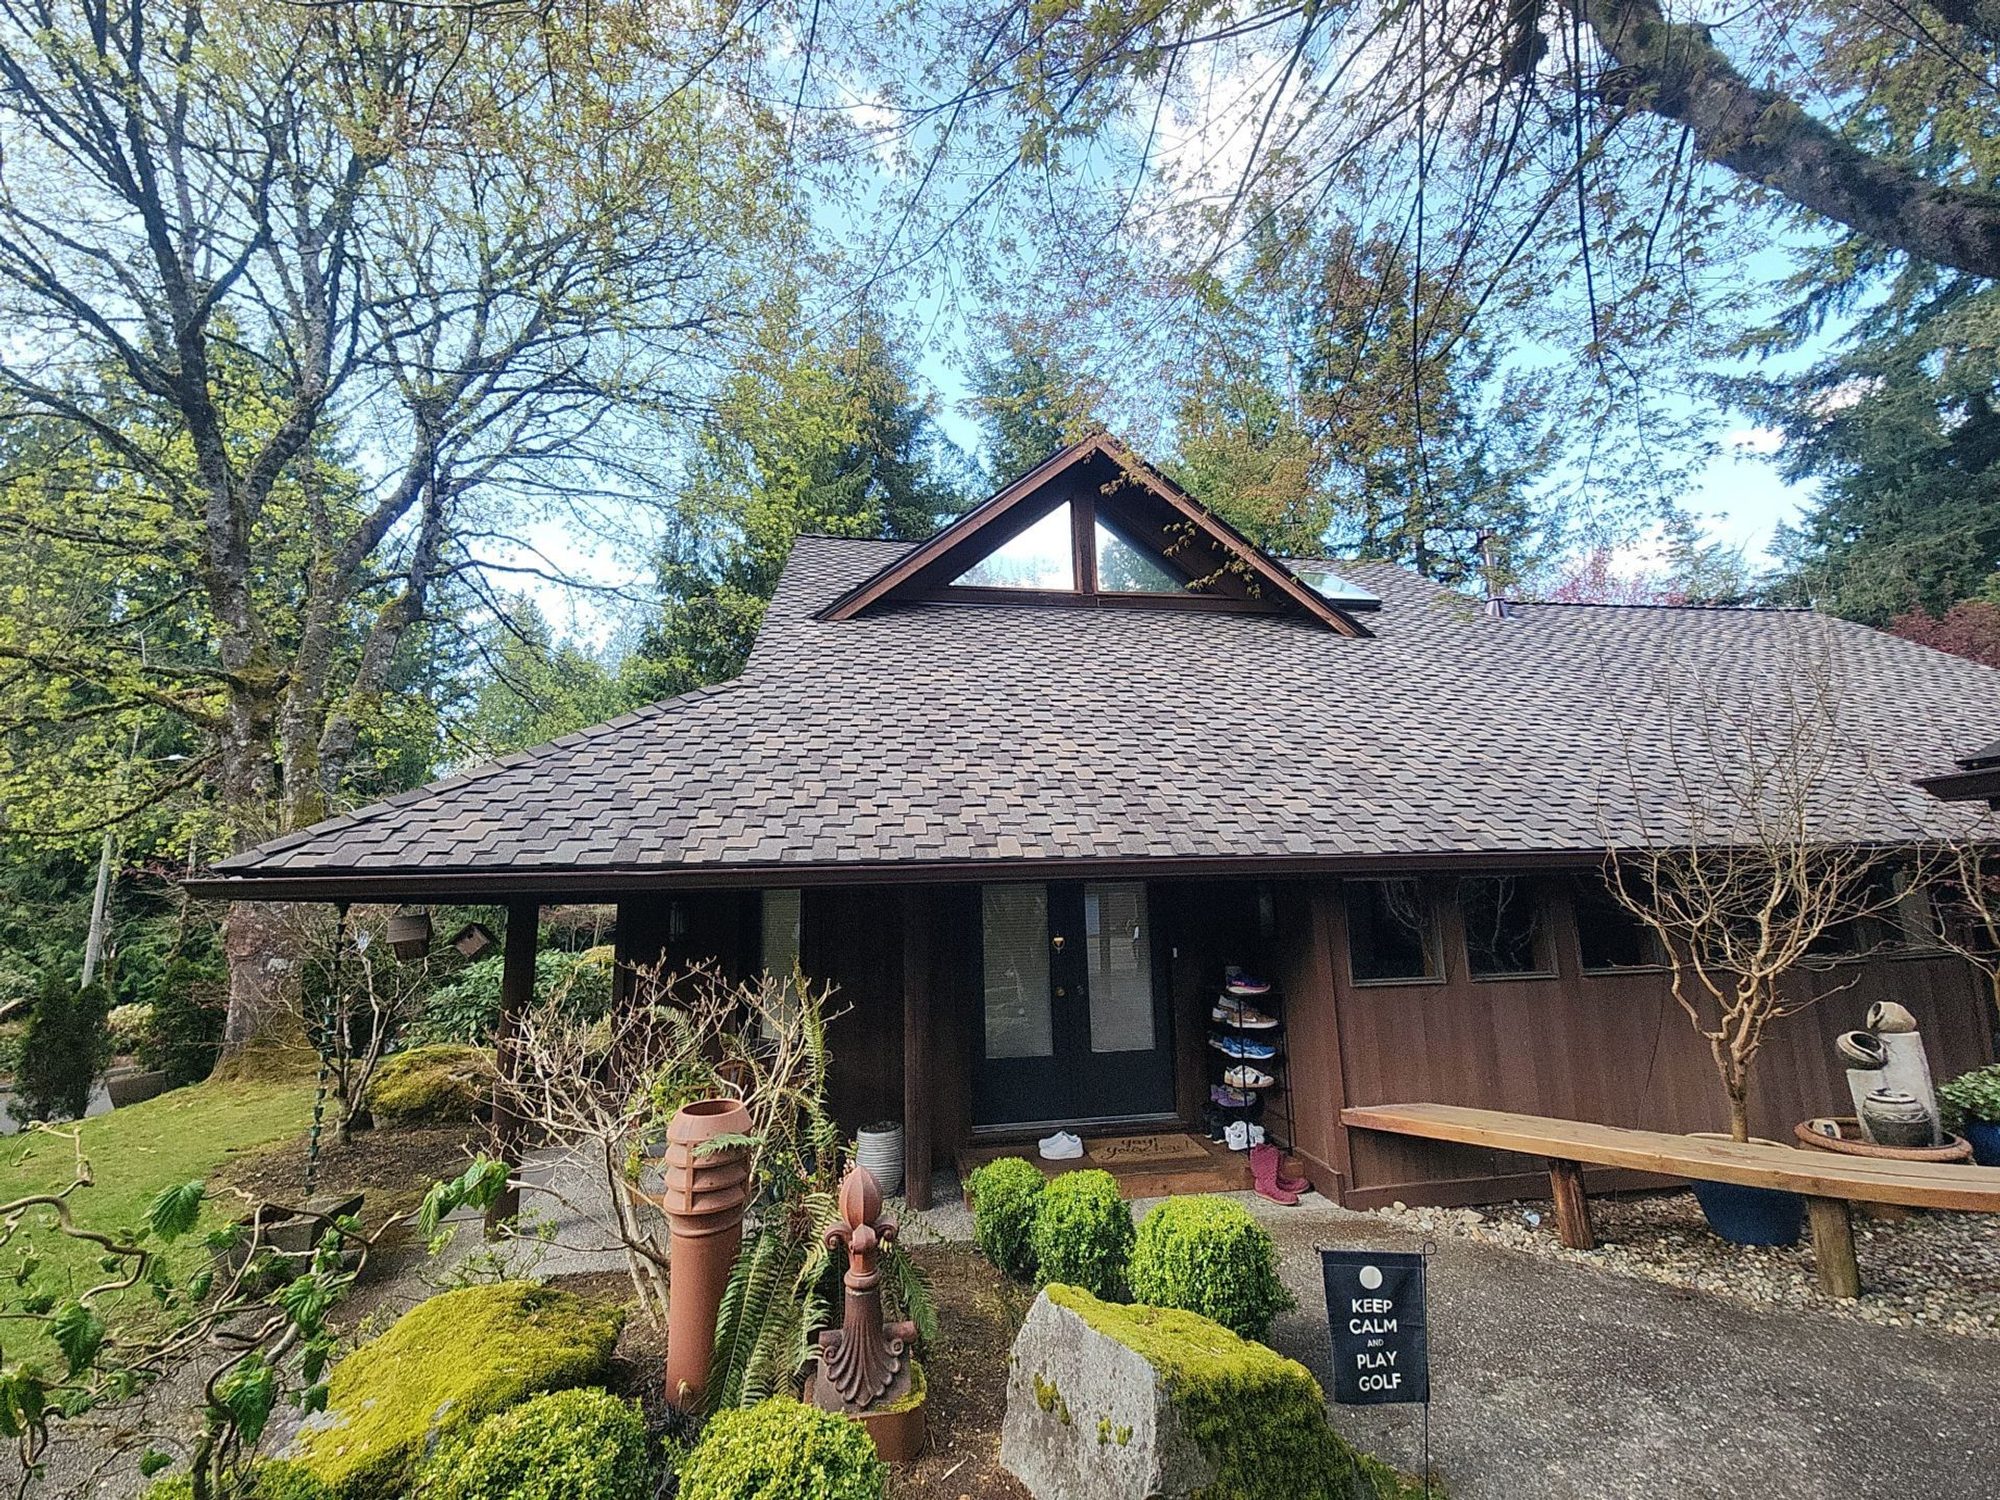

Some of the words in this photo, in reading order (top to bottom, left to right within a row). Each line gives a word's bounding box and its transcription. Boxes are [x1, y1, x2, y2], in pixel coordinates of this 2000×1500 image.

[1351, 1298, 1393, 1314] KEEP
[1349, 1318, 1398, 1335] CALM
[1367, 1338, 1384, 1348] AND
[1356, 1350, 1398, 1370] PLAY
[1358, 1372, 1402, 1392] GOLF
